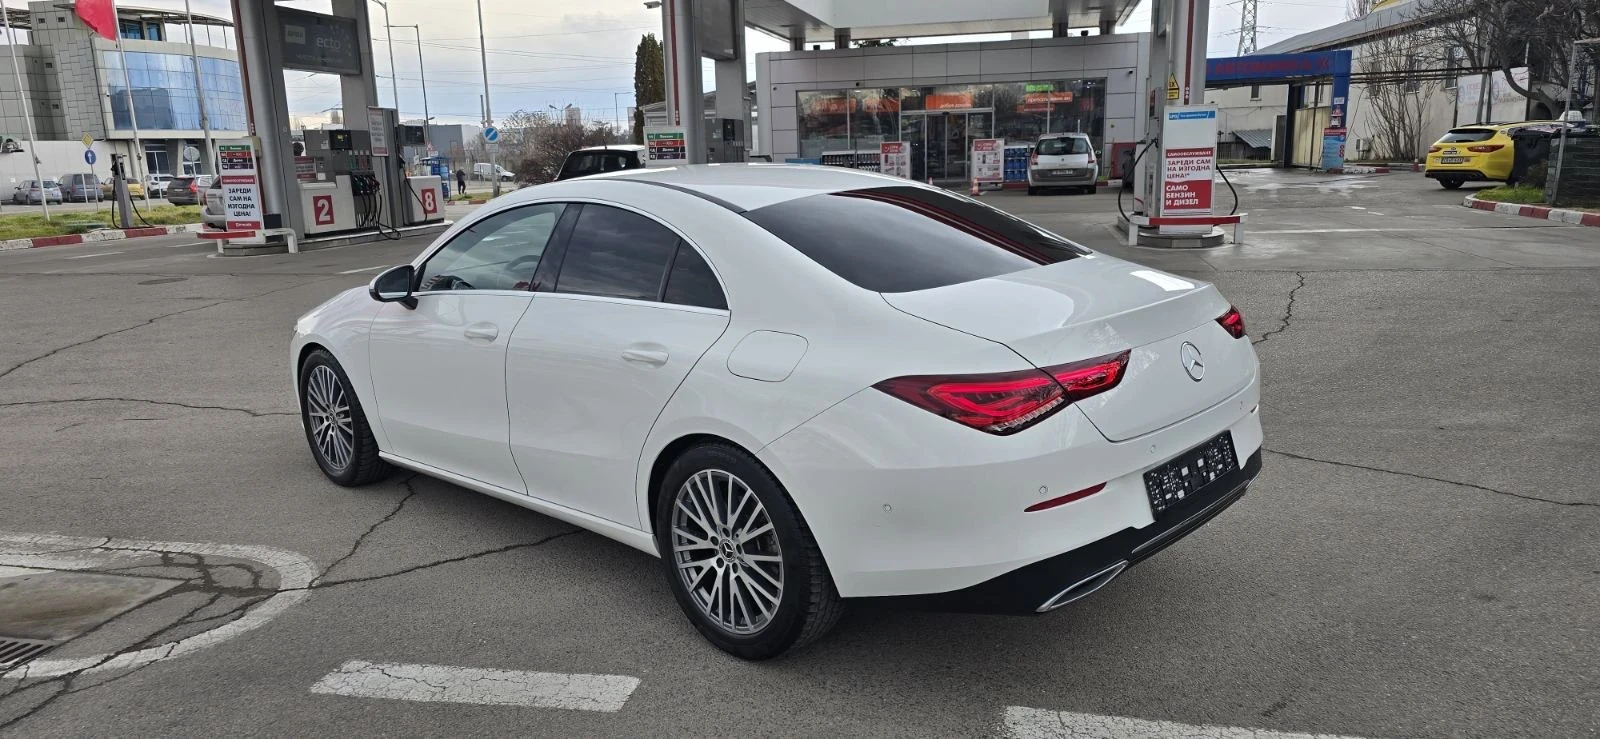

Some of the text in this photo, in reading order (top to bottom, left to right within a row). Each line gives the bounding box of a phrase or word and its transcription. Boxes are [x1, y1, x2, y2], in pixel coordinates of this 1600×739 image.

[316, 36, 341, 49] ecto
[425, 192, 434, 211] 8
[1174, 198, 1199, 206] ДИЗЕЛ
[317, 198, 331, 222] 2
